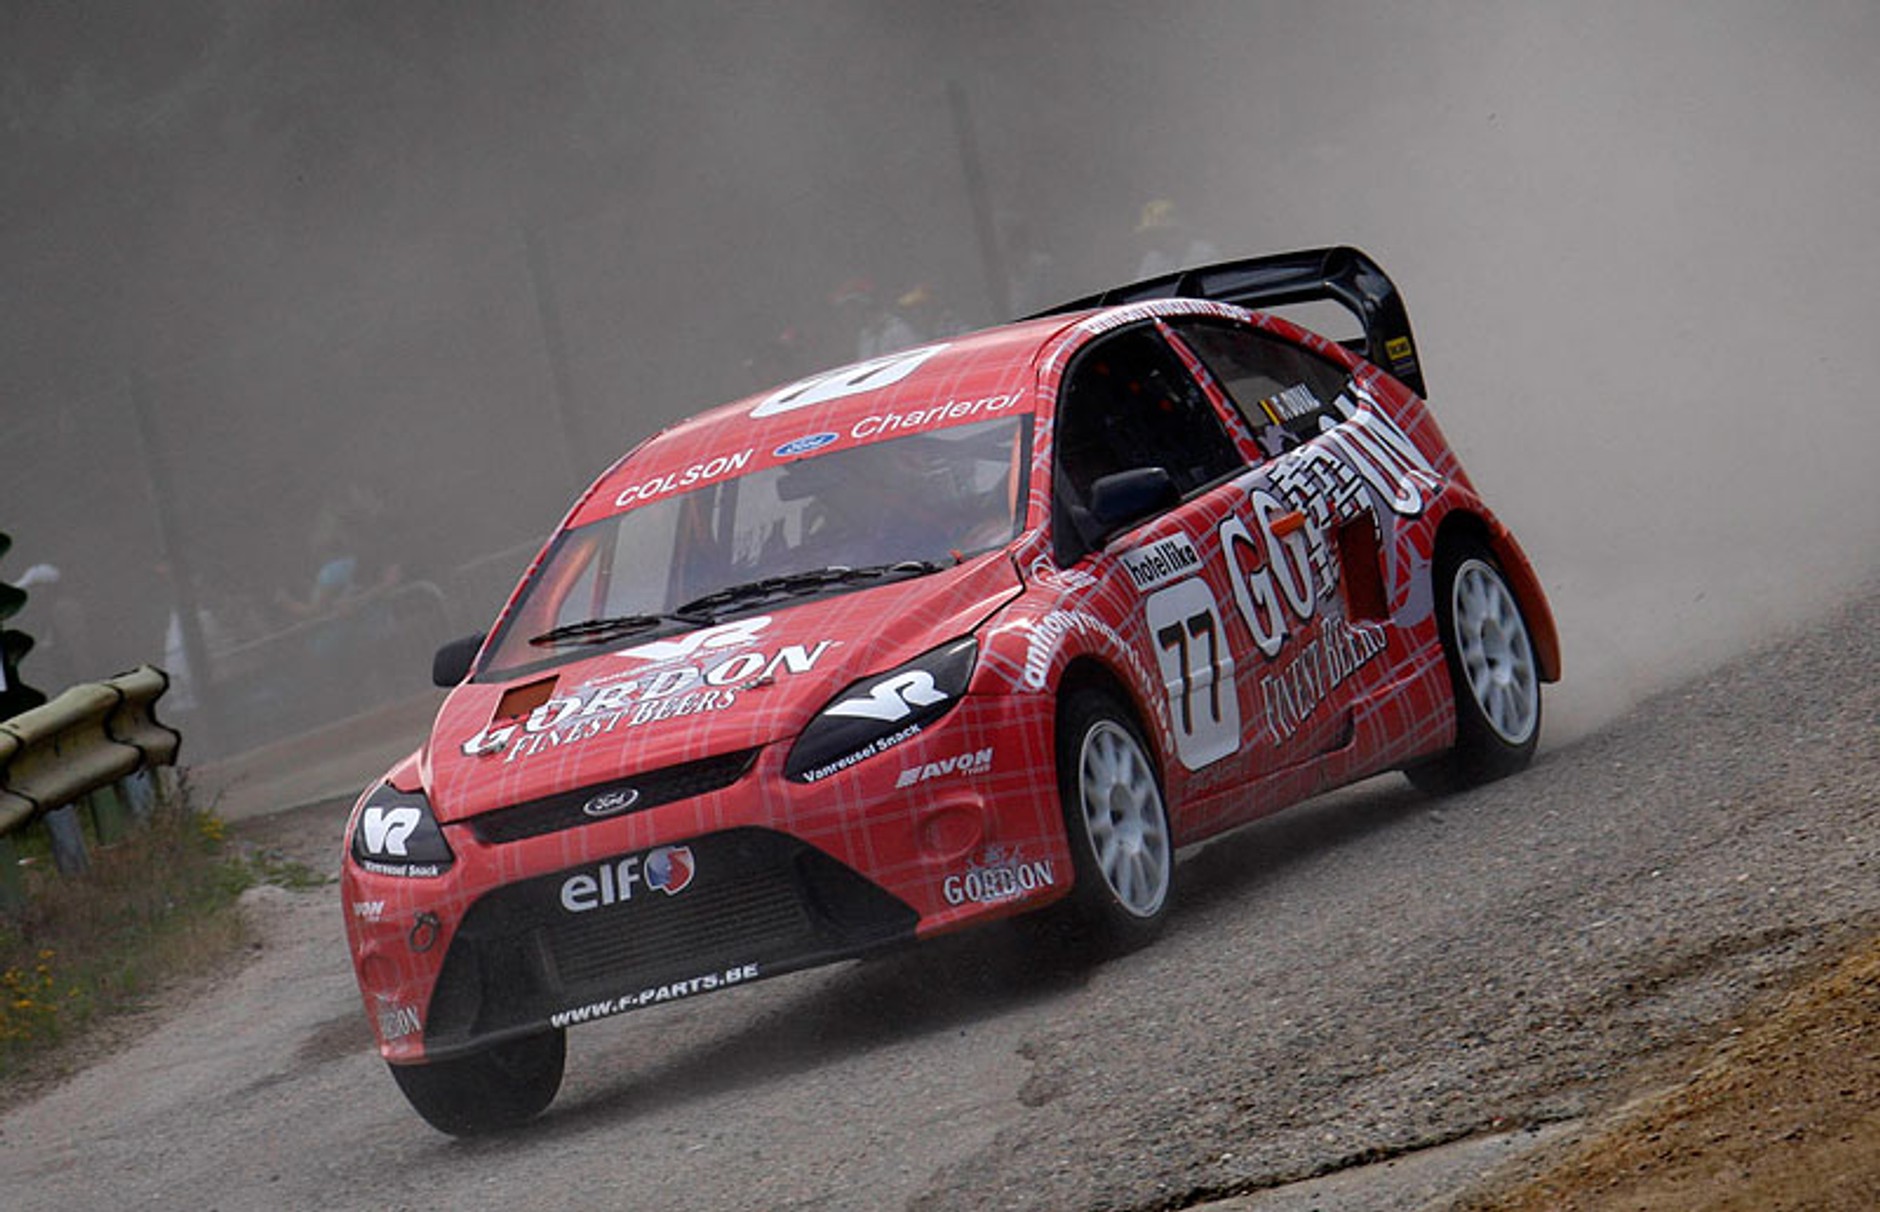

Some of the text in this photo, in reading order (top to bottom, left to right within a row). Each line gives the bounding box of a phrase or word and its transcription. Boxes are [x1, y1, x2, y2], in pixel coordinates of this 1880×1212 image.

[615, 448, 754, 507] COLSON
[850, 388, 1026, 439] Charleroi
[1157, 608, 1221, 736] 77
[504, 688, 738, 764] FINEST BEERS
[802, 723, 921, 783] Vanreusel Snack
[918, 747, 994, 781] AVON
[561, 856, 640, 912] elf
[944, 860, 1054, 905] GORDON
[551, 963, 761, 1028] WWW.F-PARTS.BE
